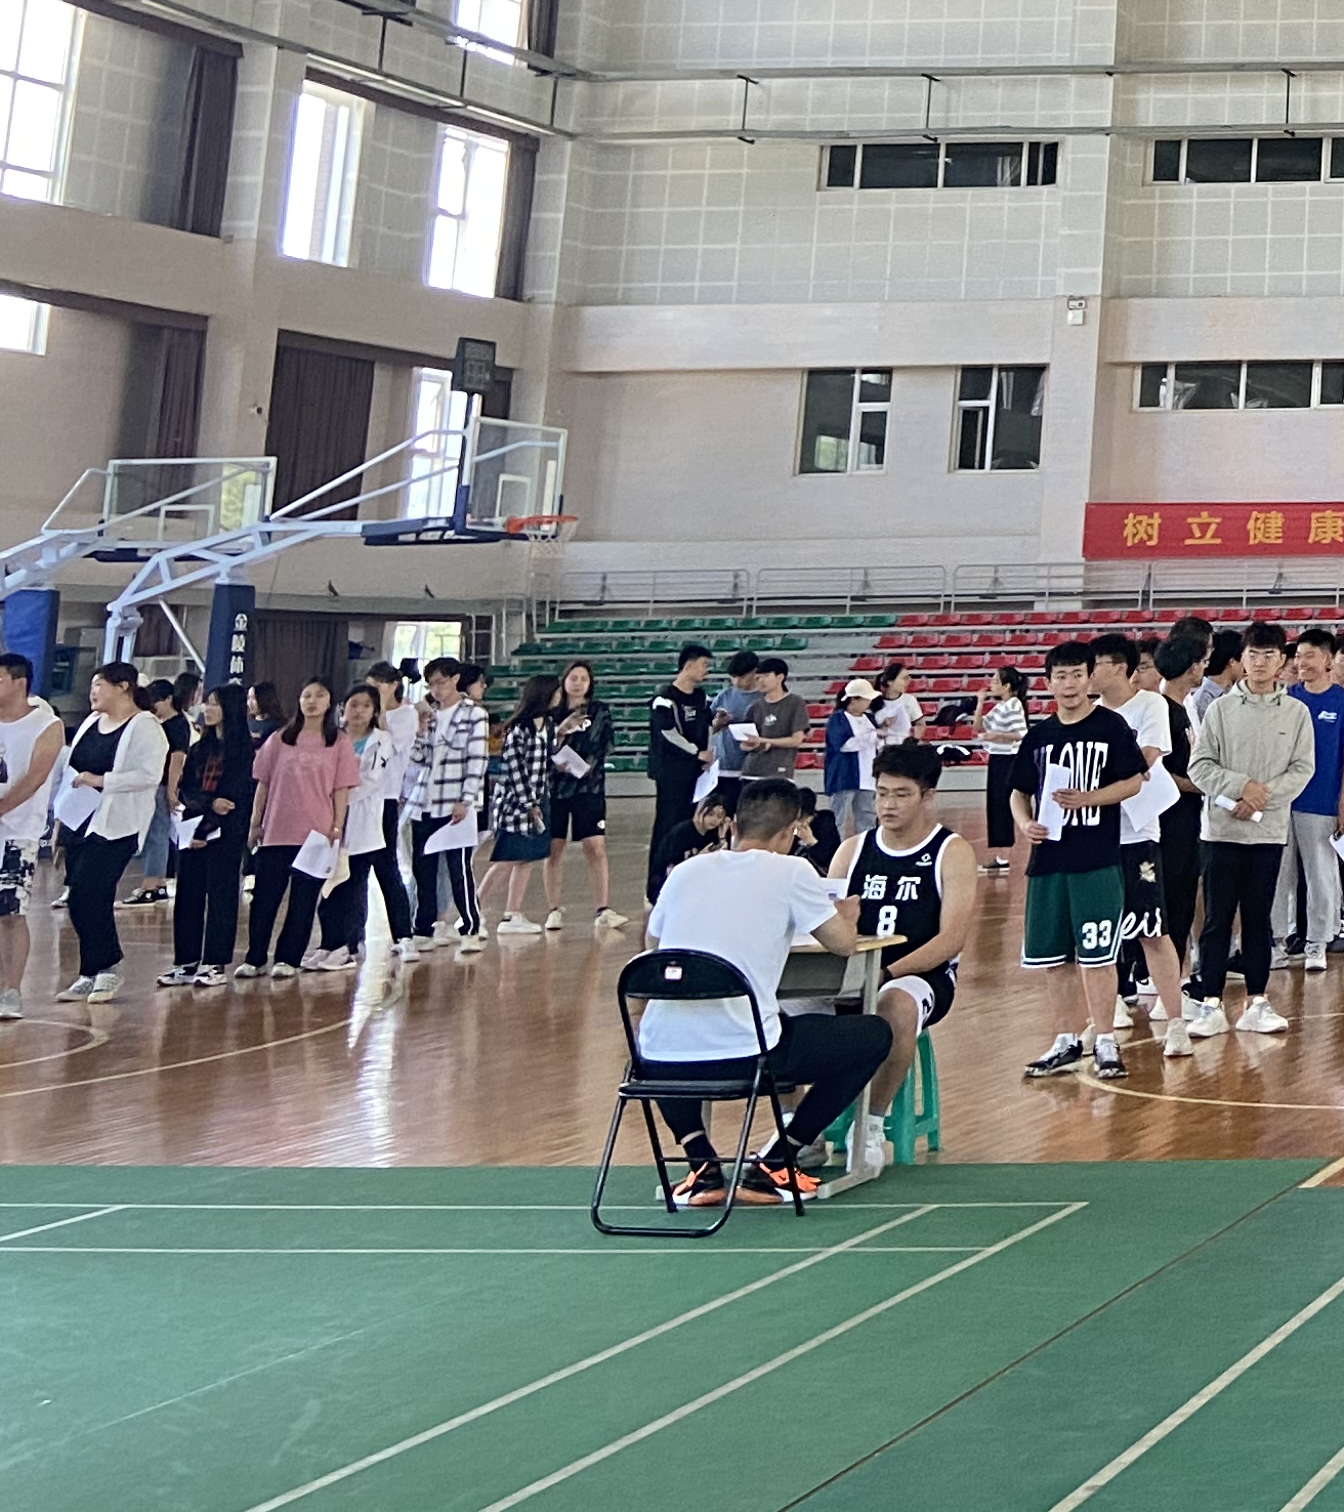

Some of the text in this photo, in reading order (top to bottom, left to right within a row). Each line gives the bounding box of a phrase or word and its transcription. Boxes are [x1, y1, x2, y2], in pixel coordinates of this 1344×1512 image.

[861, 874, 921, 901] 海尔
[877, 905, 898, 938] 8
[1082, 919, 1112, 950] 33
